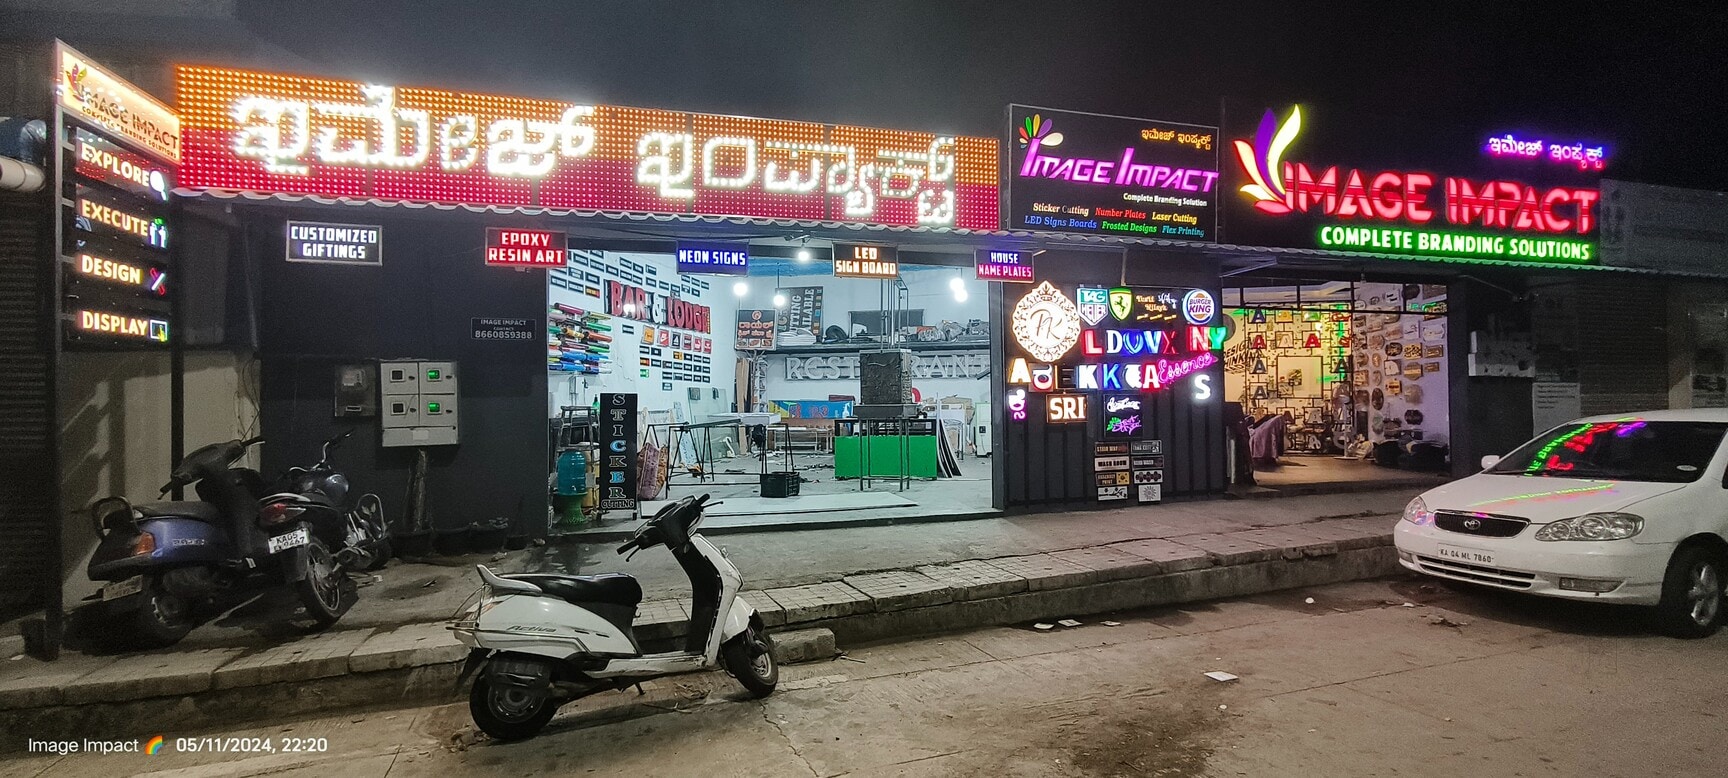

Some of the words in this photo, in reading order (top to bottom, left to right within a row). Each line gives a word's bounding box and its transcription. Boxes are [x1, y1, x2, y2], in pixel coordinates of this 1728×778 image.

[132, 113, 178, 149] IMPACT
[81, 143, 150, 188] EXPLORE
[1019, 138, 1115, 184] IMAGE
[1115, 147, 1219, 193] IMPACT
[1123, 192, 1153, 203] Complete
[1154, 195, 1182, 206] Branding
[1183, 197, 1208, 207] Solution
[1282, 160, 1435, 223] IMAGE
[1445, 176, 1600, 234] IMPACT
[81, 199, 149, 237] EXECUTE
[1033, 202, 1060, 213] Sticker
[1061, 205, 1090, 217] Cutting
[1095, 207, 1123, 218] Number
[1124, 209, 1147, 220] Plates
[1152, 211, 1172, 222] Laser
[1172, 213, 1198, 226] Cutting
[291, 226, 377, 244] CUSTOMIZED
[1024, 215, 1042, 225] LED
[1044, 216, 1067, 228] Signs
[1068, 218, 1098, 229] Boards
[1101, 220, 1129, 232] Frosted
[1129, 222, 1158, 235] Designs
[1162, 225, 1178, 235] Flex
[1177, 226, 1205, 238] Printing
[501, 232, 550, 247] EPOXY
[1321, 226, 1413, 250] COMPLETE
[1418, 232, 1504, 255] BRANDING
[1509, 238, 1590, 260] SOLUTIONS
[302, 242, 366, 260] GIFTINGS
[488, 248, 532, 263] RESIN
[535, 249, 564, 264] ART
[679, 249, 710, 264] NEON
[712, 251, 746, 266] SIGNS
[854, 246, 878, 260] LED
[990, 252, 1018, 264] HOUSE
[81, 253, 143, 285] DESIGN
[835, 260, 859, 273] SIGN
[862, 261, 896, 275] BOARD
[978, 264, 1001, 276] NAME
[1002, 265, 1032, 278] PLATES
[611, 280, 646, 321] BAR
[1081, 290, 1105, 303] TAG
[1188, 298, 1212, 306] BURGER
[1188, 304, 1212, 314] KING
[82, 310, 148, 337] DISPLAY
[475, 330, 532, 339] 8660859388
[1050, 397, 1087, 421] SRI
[608, 394, 628, 498] STICKER
[506, 624, 557, 633] Activa
